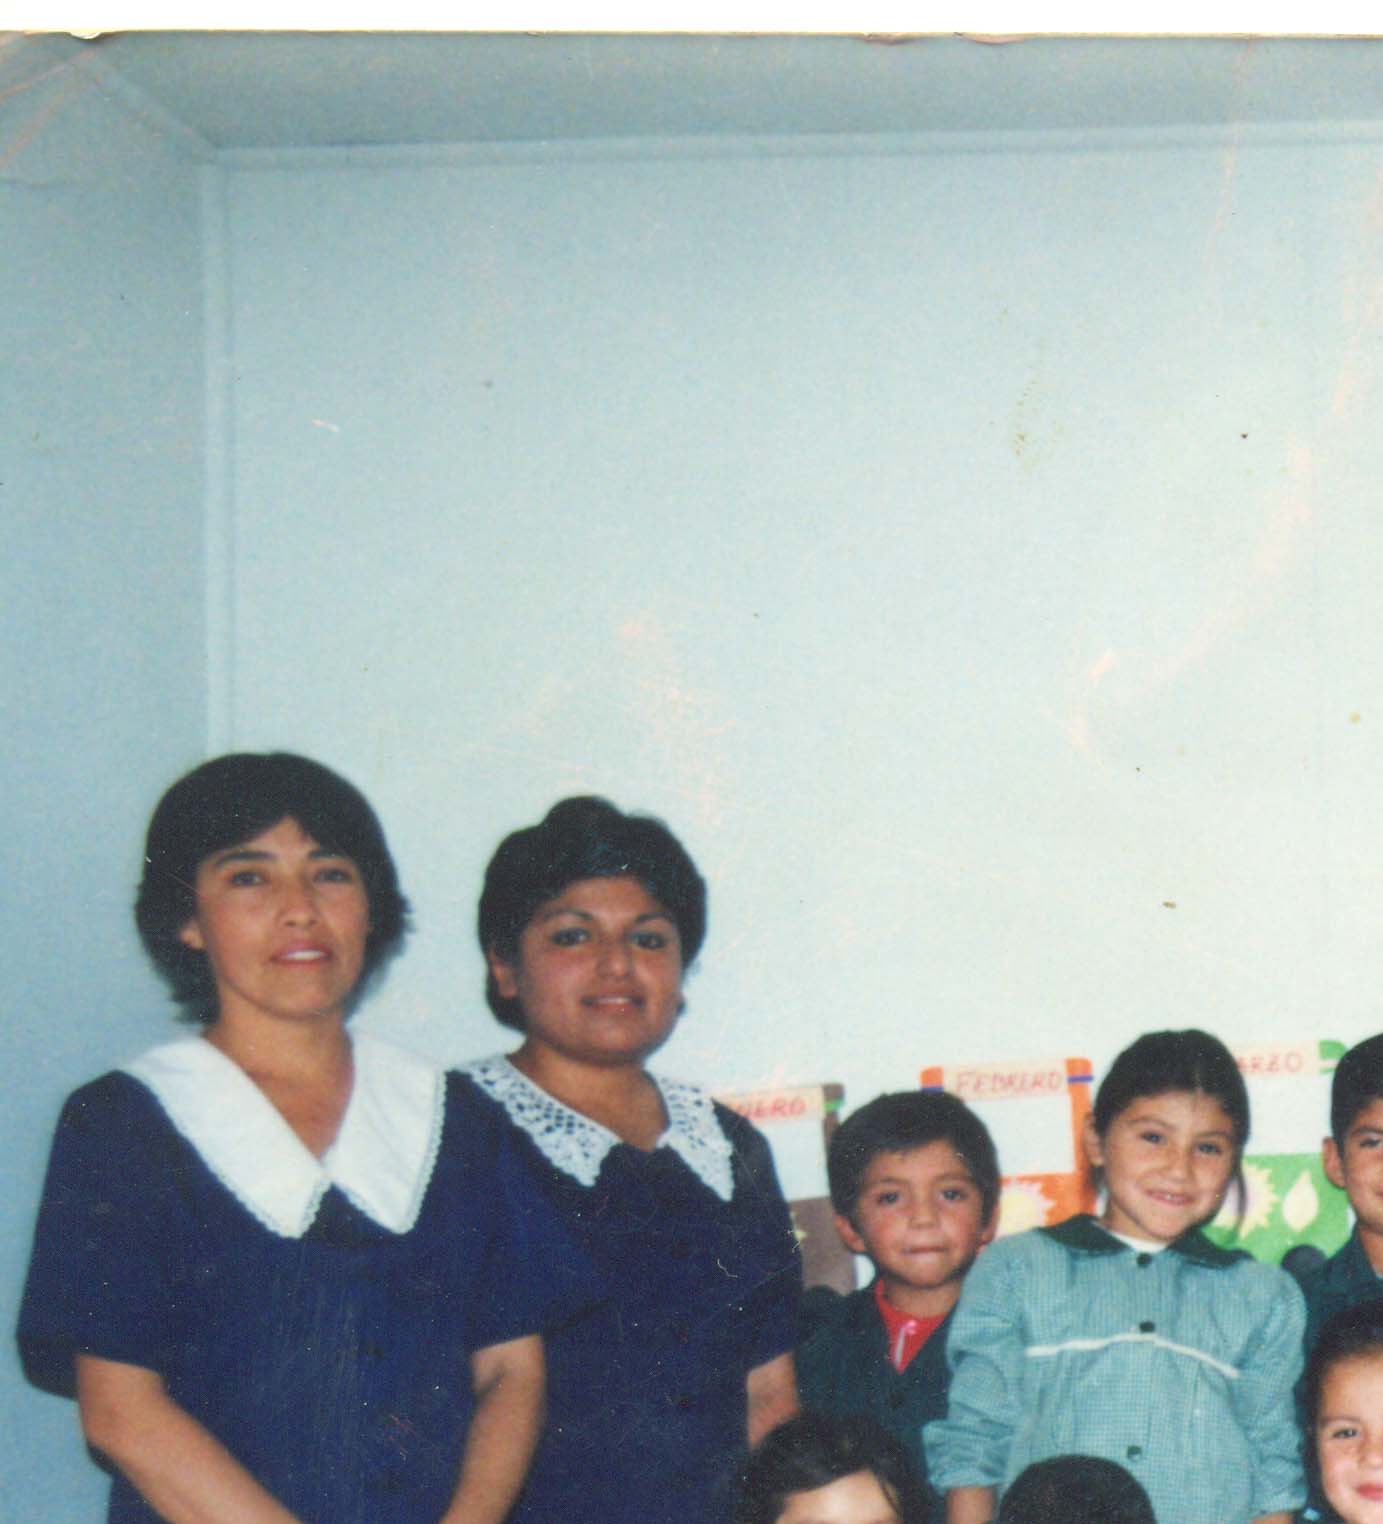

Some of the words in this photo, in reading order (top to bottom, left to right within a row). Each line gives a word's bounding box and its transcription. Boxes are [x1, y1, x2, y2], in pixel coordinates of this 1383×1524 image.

[1238, 1051, 1303, 1074] ARZO
[957, 1071, 1062, 1095] FEBRERO
[735, 1097, 806, 1118] NERO
